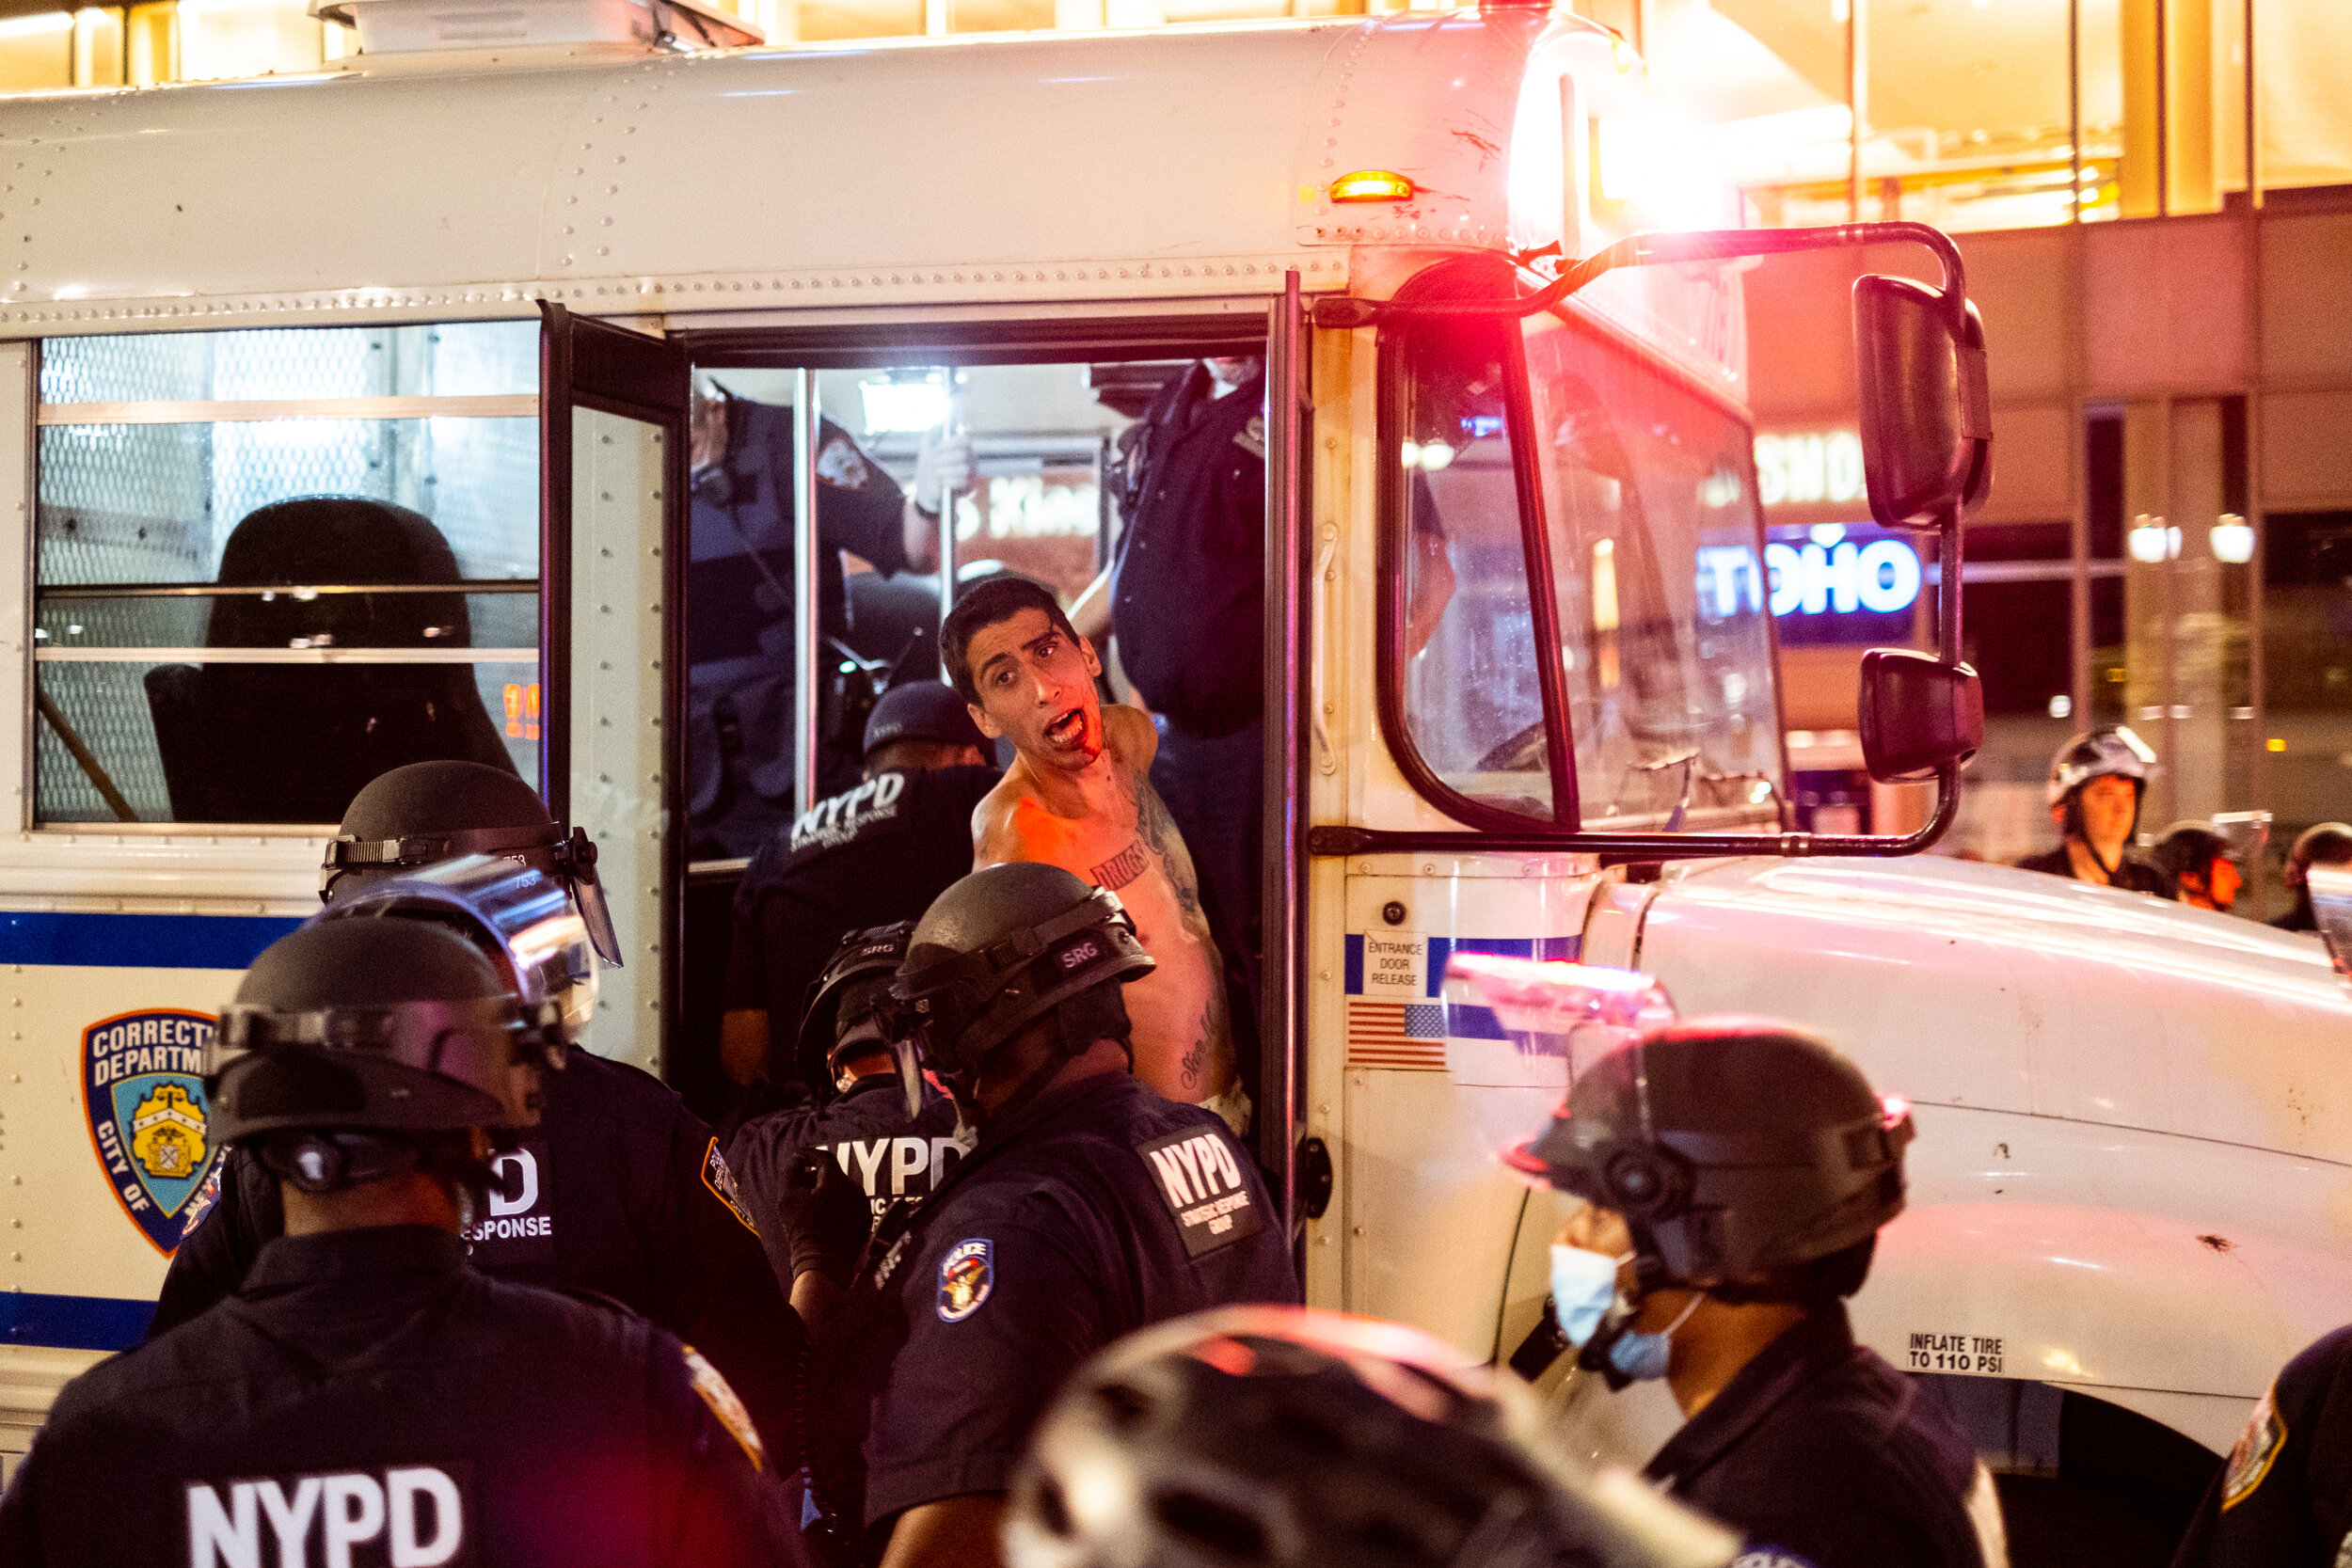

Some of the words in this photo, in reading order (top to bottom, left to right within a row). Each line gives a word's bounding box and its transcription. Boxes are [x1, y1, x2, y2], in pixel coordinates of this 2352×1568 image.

[791, 773, 904, 835] NYPD
[1062, 942, 1099, 968] SRG
[1369, 942, 1423, 956] ENTRANCE
[1380, 958, 1410, 970] DOOR
[1372, 973, 1417, 986] RELEASE
[92, 1020, 214, 1058] CORRECT
[94, 1046, 202, 1086] DEPARTM
[97, 1120, 130, 1175] CITY
[123, 1182, 151, 1212] OF
[1149, 1133, 1242, 1209] NYPD
[460, 1216, 552, 1241] SPONSE
[1910, 1333, 1965, 1352] INFLATE
[1972, 1337, 2002, 1354] TIRE
[1910, 1351, 1931, 1368] TO
[1935, 1354, 1971, 1370] 110
[1977, 1355, 2002, 1372] PSI
[186, 1466, 463, 1568] NYPD
